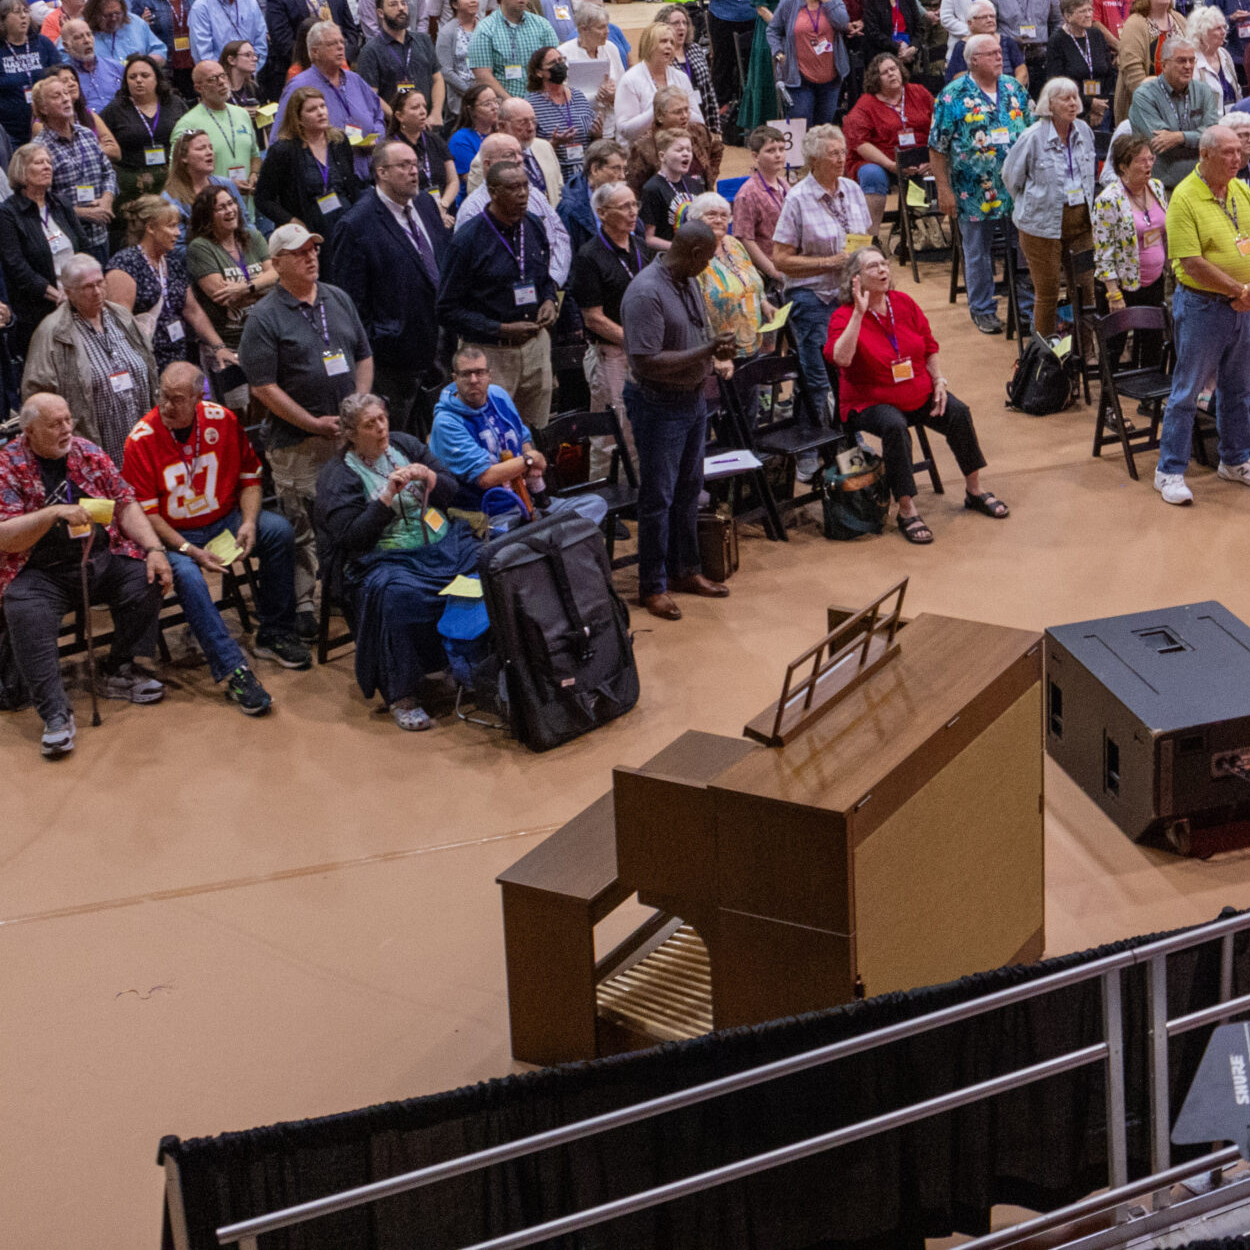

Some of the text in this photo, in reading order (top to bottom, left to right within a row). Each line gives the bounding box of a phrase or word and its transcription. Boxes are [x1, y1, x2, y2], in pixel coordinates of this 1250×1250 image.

[783, 132, 793, 150] 3
[163, 451, 220, 520] 87
[1230, 1054, 1250, 1105] SHURE
